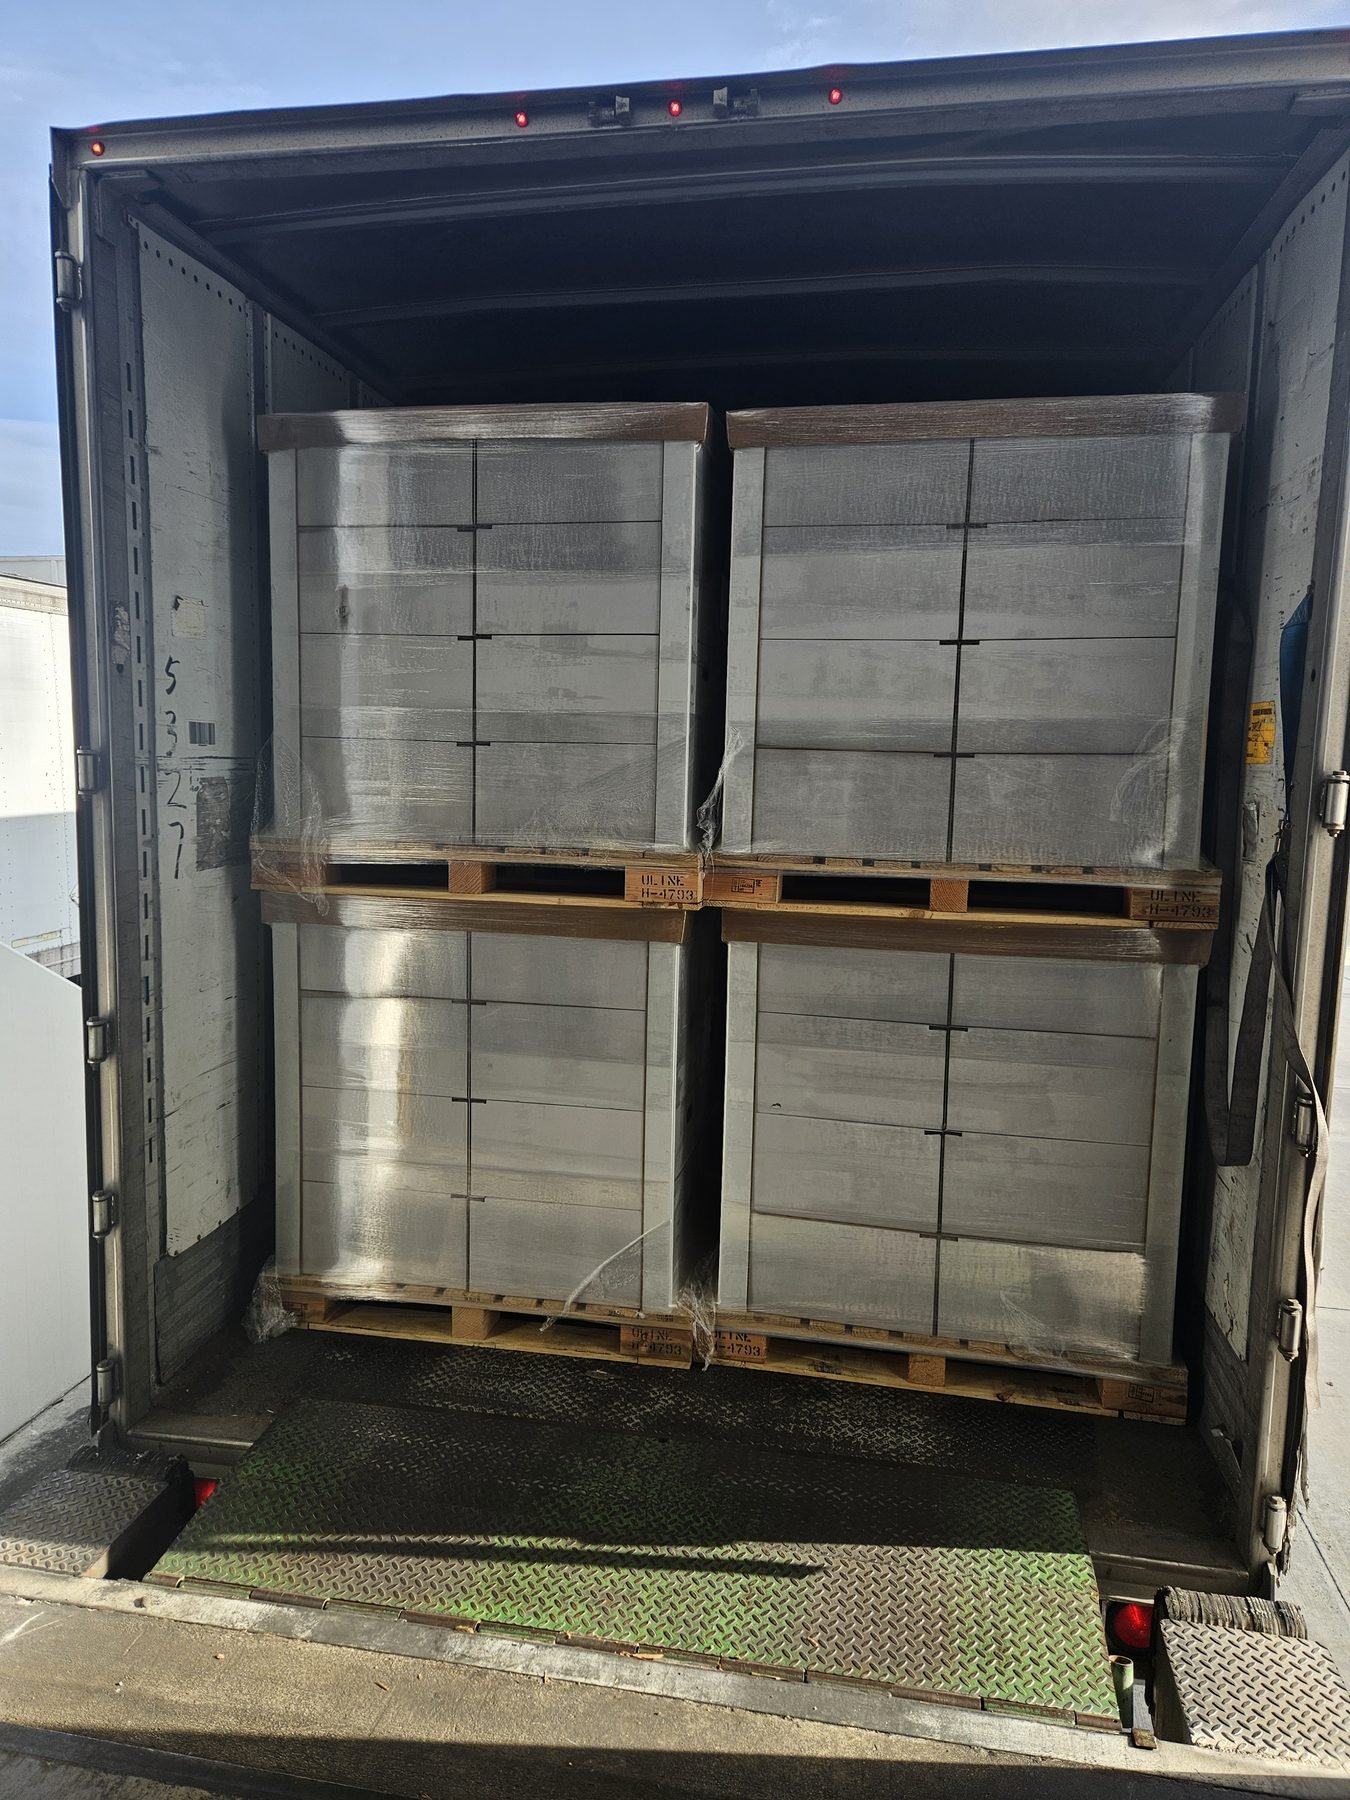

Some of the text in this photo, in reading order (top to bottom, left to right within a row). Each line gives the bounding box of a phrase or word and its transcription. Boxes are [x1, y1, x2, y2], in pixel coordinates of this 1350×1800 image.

[641, 874, 685, 887] ULINE
[641, 887, 694, 901] H-4793
[1150, 889, 1202, 903] ULINE
[1149, 903, 1212, 918] H-4793
[631, 1341, 682, 1356] H4793
